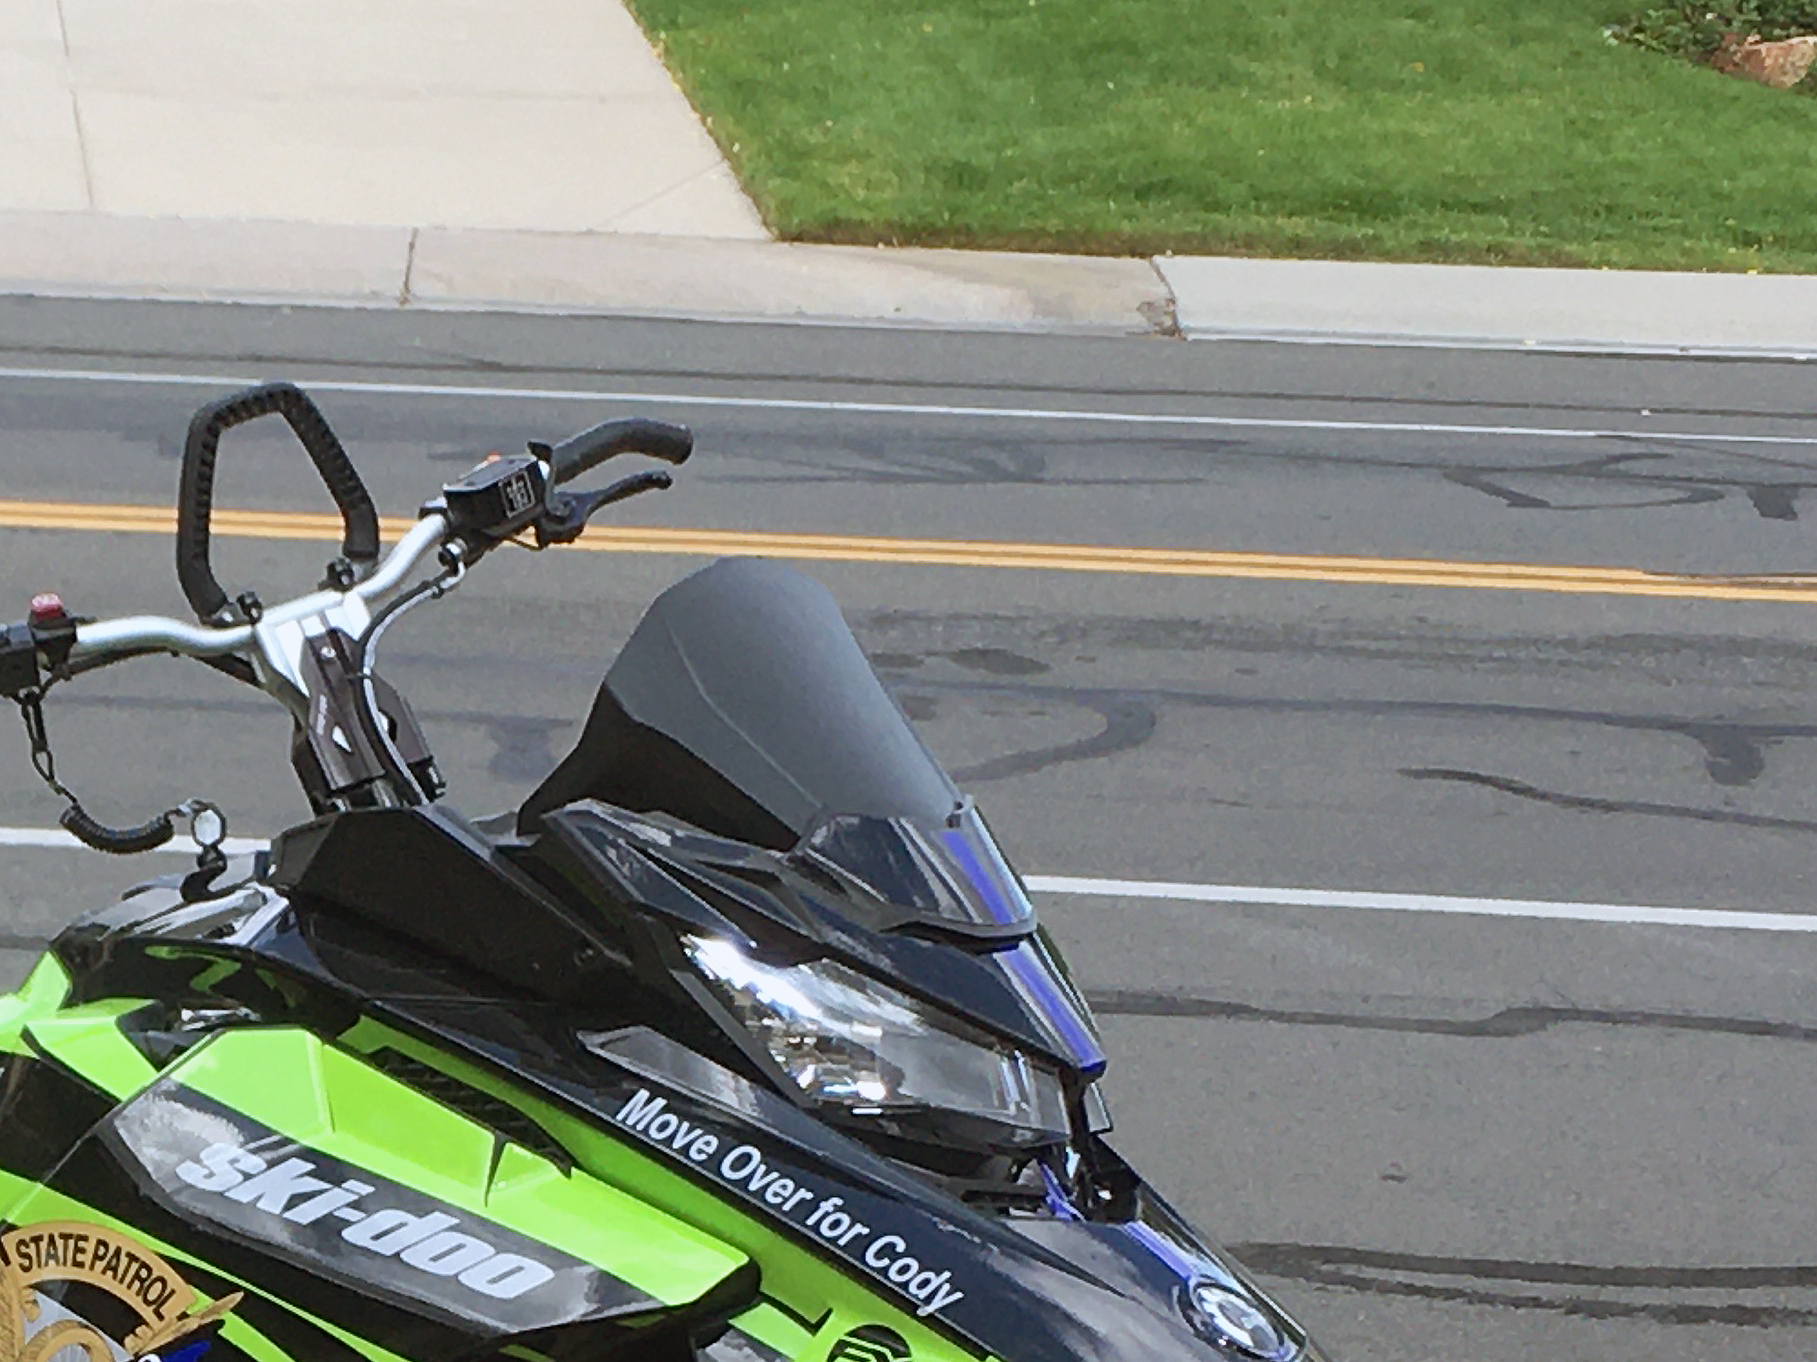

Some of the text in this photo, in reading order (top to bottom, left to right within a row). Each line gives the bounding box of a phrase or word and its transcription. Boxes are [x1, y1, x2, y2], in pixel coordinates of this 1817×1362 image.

[15, 1232, 177, 1323] STATE PATROL
[616, 1087, 965, 1317] Move Over for Cody
